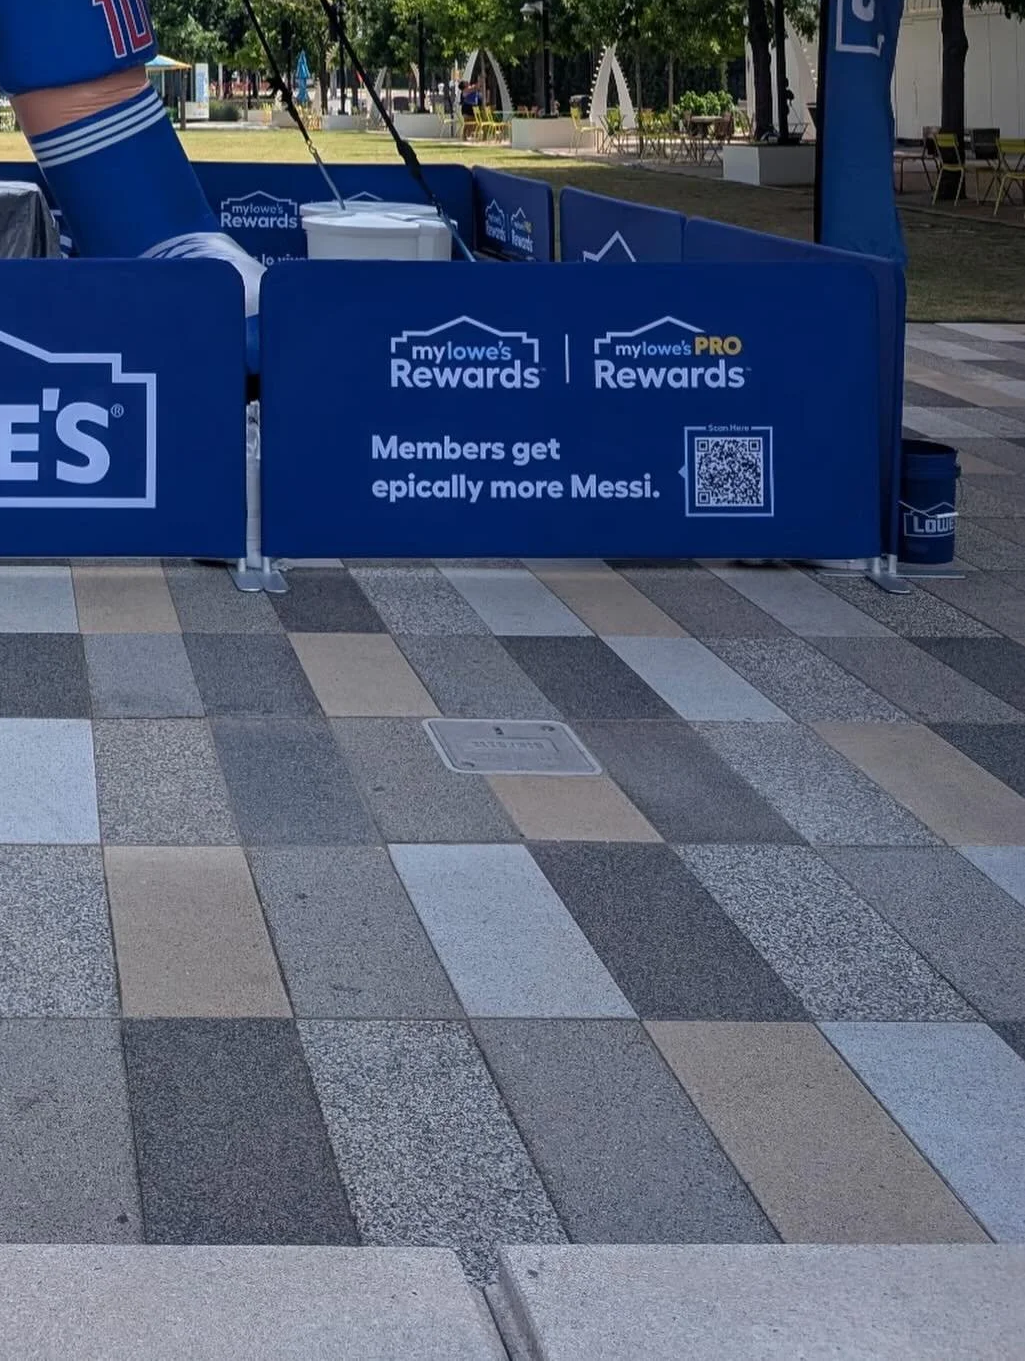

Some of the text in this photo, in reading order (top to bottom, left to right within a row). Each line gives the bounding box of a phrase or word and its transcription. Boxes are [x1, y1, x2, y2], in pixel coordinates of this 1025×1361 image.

[220, 212, 298, 228] Rewards
[412, 341, 512, 364] mylowe's
[616, 336, 743, 358] mylowe's PRO
[390, 358, 541, 389] Rewards
[594, 359, 745, 389] Rewards
[372, 435, 561, 467] Members get
[372, 472, 660, 503] epically more Messi.
